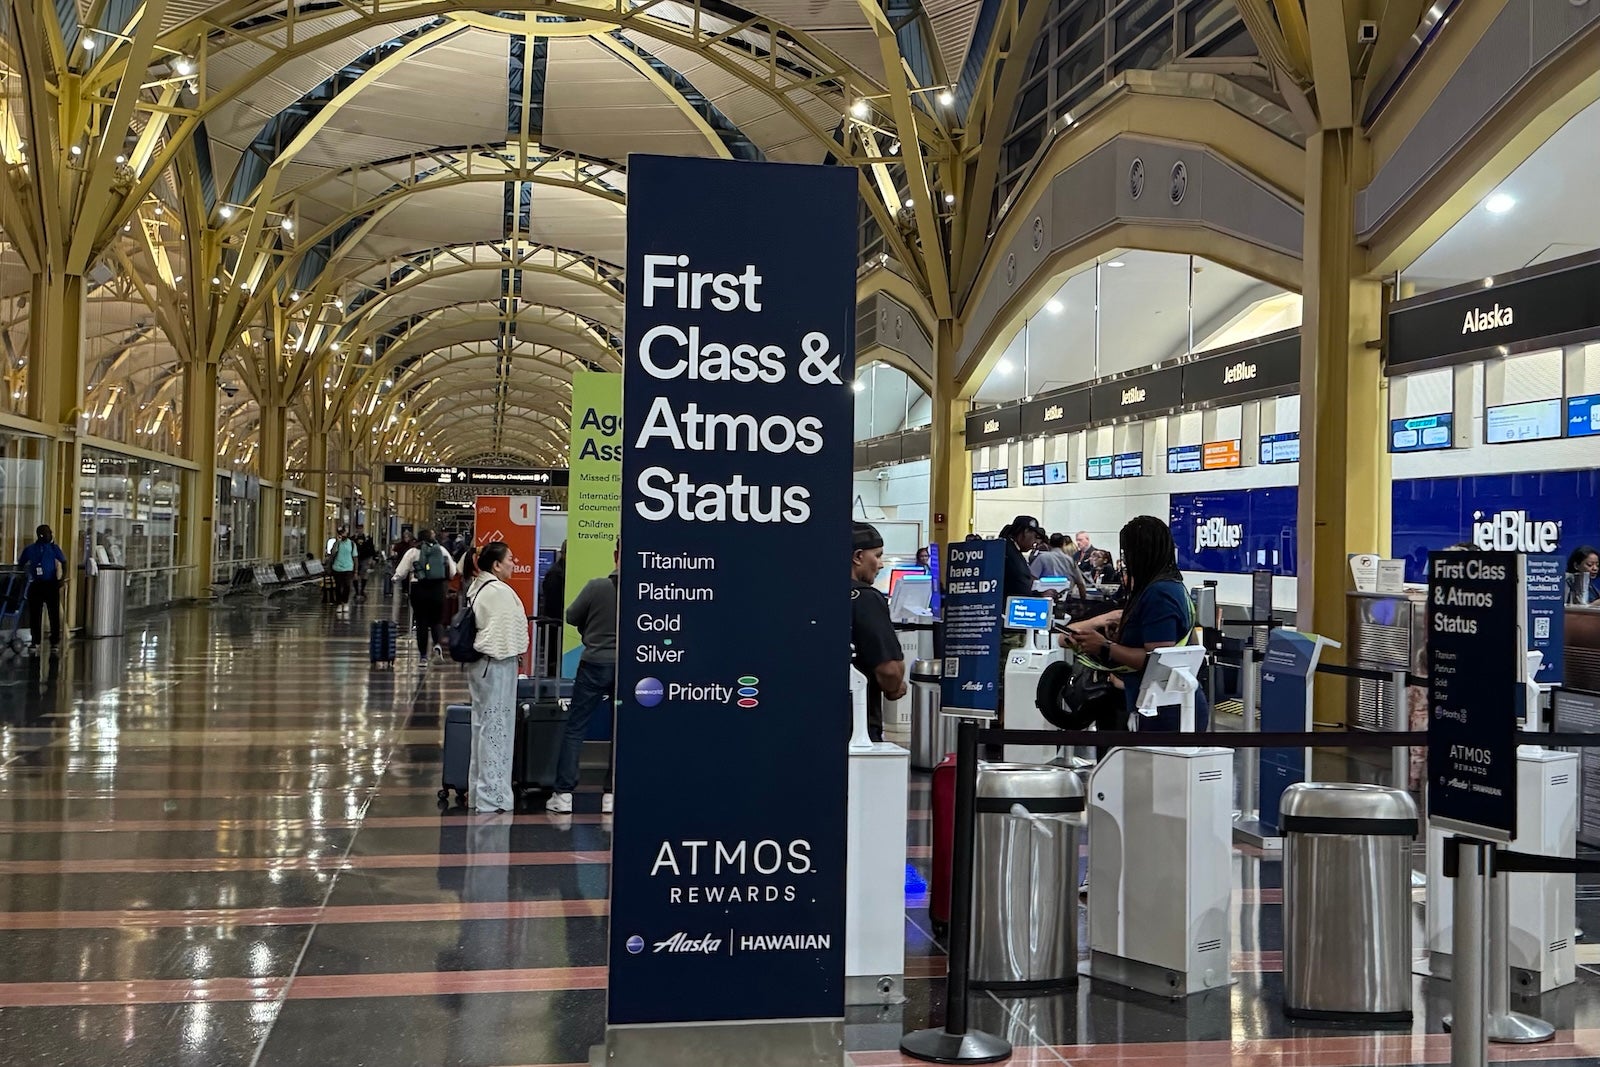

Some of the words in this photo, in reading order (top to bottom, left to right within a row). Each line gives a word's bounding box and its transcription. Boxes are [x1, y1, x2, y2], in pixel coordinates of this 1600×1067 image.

[642, 254, 763, 313] First
[1462, 303, 1513, 335] Alaska
[638, 324, 787, 384] Class
[798, 331, 844, 385] &
[1223, 361, 1257, 384] JetBlue
[1121, 387, 1146, 405] JetBlue
[580, 407, 622, 437] Ag
[1043, 405, 1063, 422] JetBlue
[634, 396, 824, 455] Atmos
[984, 419, 1000, 434] JetBlue
[580, 474, 610, 482] Missed
[579, 492, 621, 500] Internatio
[634, 466, 811, 524] Status
[520, 503, 528, 519] 1
[578, 520, 614, 529] Children
[1473, 510, 1559, 553] jetBlue
[577, 532, 614, 542] traveling
[1195, 517, 1240, 554] jetBlue
[637, 551, 715, 570] Titanium
[951, 549, 965, 561] Do
[965, 550, 984, 563] you
[949, 565, 972, 578] have
[973, 567, 980, 577] a
[1434, 559, 1465, 579] First
[1466, 559, 1506, 580] Class
[638, 582, 714, 601] Platinum
[948, 581, 978, 594] REAL
[978, 580, 998, 593] ID?
[1434, 585, 1445, 605] &
[1447, 586, 1493, 608] Atmos
[636, 613, 681, 632] Gold
[1434, 612, 1478, 634] Status
[635, 644, 685, 663] Silver
[668, 682, 734, 704] Priority
[1449, 744, 1492, 766] ATMOS
[650, 839, 812, 876] ATMOS
[670, 885, 796, 904] REWARDS
[653, 931, 722, 955] Alaska
[740, 934, 831, 951] HAWAIIAN
